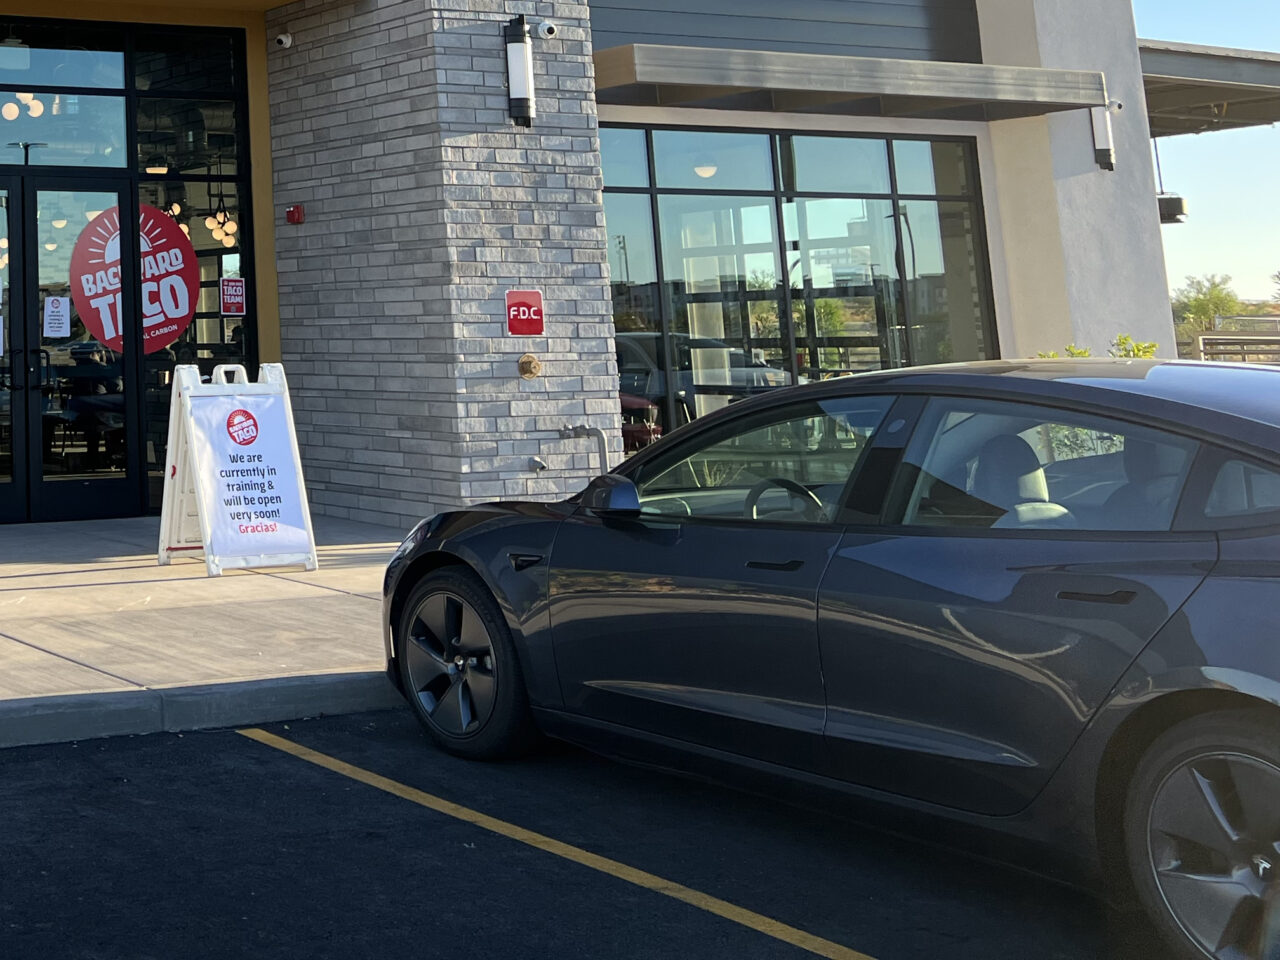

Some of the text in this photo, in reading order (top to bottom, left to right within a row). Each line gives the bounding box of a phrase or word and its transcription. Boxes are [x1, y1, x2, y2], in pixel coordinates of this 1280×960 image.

[81, 248, 185, 297] BACARD
[223, 286, 243, 295] TACO
[150, 324, 178, 337] CARBON
[232, 425, 257, 443] TACO
[229, 454, 263, 463] We are
[220, 465, 277, 479] currently in
[227, 480, 275, 493] training &
[223, 495, 282, 507] will be open
[230, 508, 280, 522] very soon!
[239, 522, 278, 533] Gracias!
